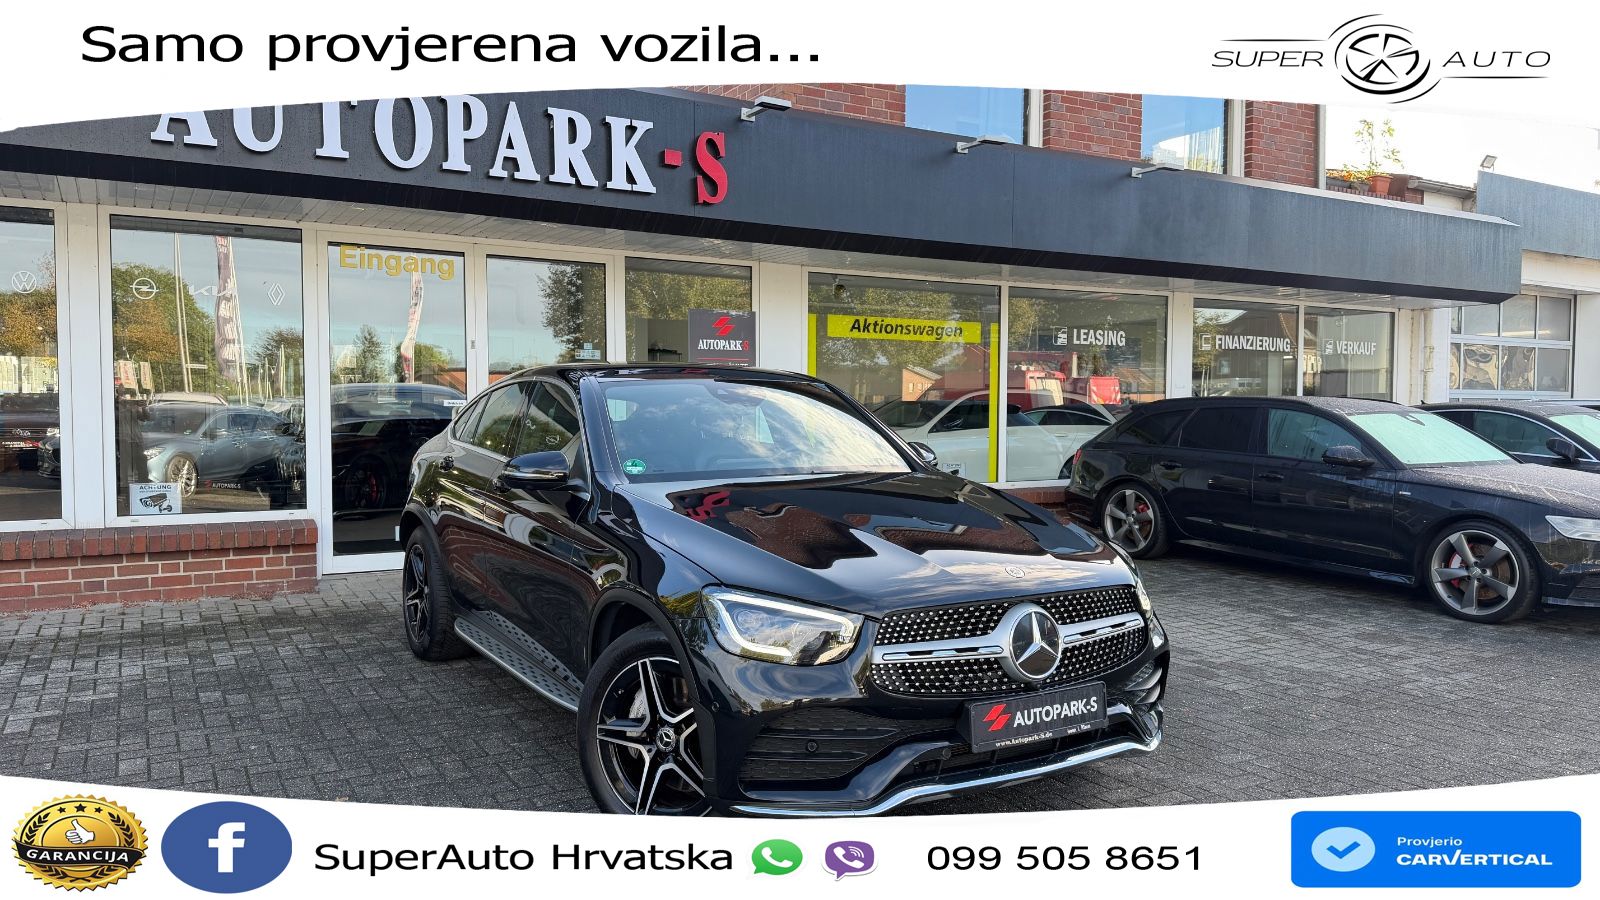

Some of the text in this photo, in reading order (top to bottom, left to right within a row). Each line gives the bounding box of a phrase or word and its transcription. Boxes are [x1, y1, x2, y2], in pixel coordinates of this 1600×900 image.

[339, 244, 455, 280] Eingang
[850, 318, 963, 340] Aktionswagen
[1073, 328, 1126, 346] LEASING
[1215, 334, 1291, 353] FINANZIERUNG
[1336, 340, 1377, 355] VERKAUF
[1013, 696, 1098, 728] AUTOPARK-S
